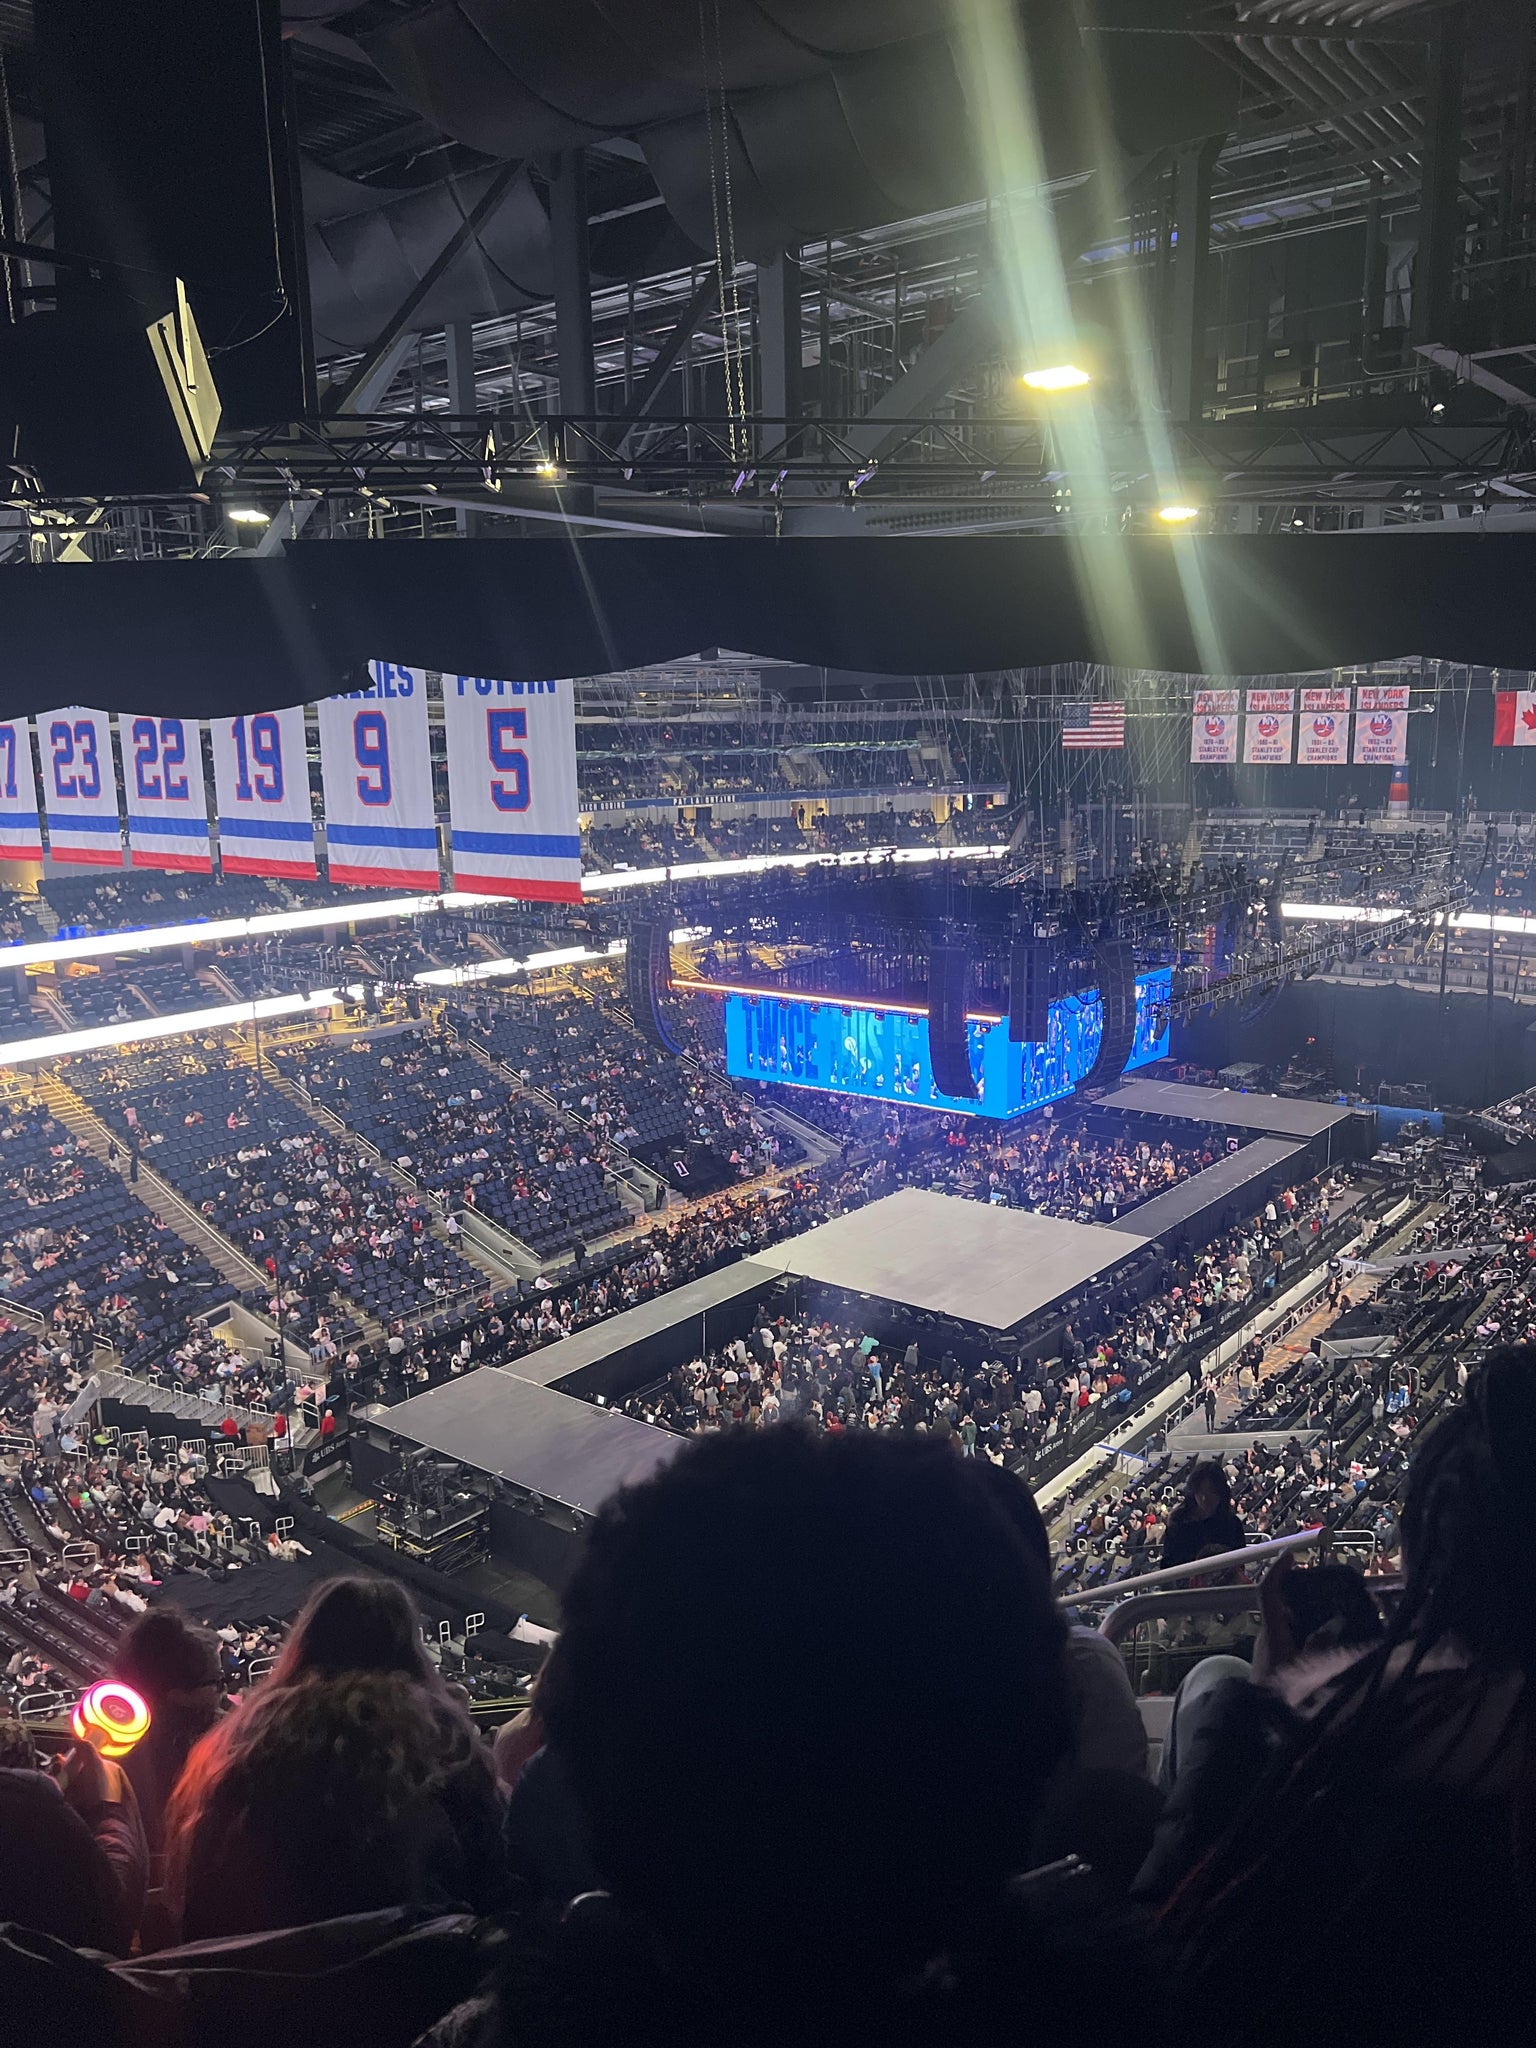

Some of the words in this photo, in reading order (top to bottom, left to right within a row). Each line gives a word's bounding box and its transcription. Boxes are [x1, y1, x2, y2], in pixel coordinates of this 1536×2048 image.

[1270, 690, 1290, 701] YORK
[1383, 688, 1404, 699] YORK
[0, 724, 17, 798] 7
[50, 720, 101, 799] 23
[132, 717, 189, 801] 22
[232, 713, 285, 803] 19
[353, 710, 392, 807] 9
[486, 707, 531, 812] 5
[580, 803, 598, 812] UTCH
[673, 798, 687, 806] PAT
[742, 997, 819, 1080] TWICE
[1228, 1140, 1237, 1152] C
[676, 1162, 687, 1175] 1
[321, 1443, 335, 1457] UBS
[1041, 1443, 1053, 1457] UBS
